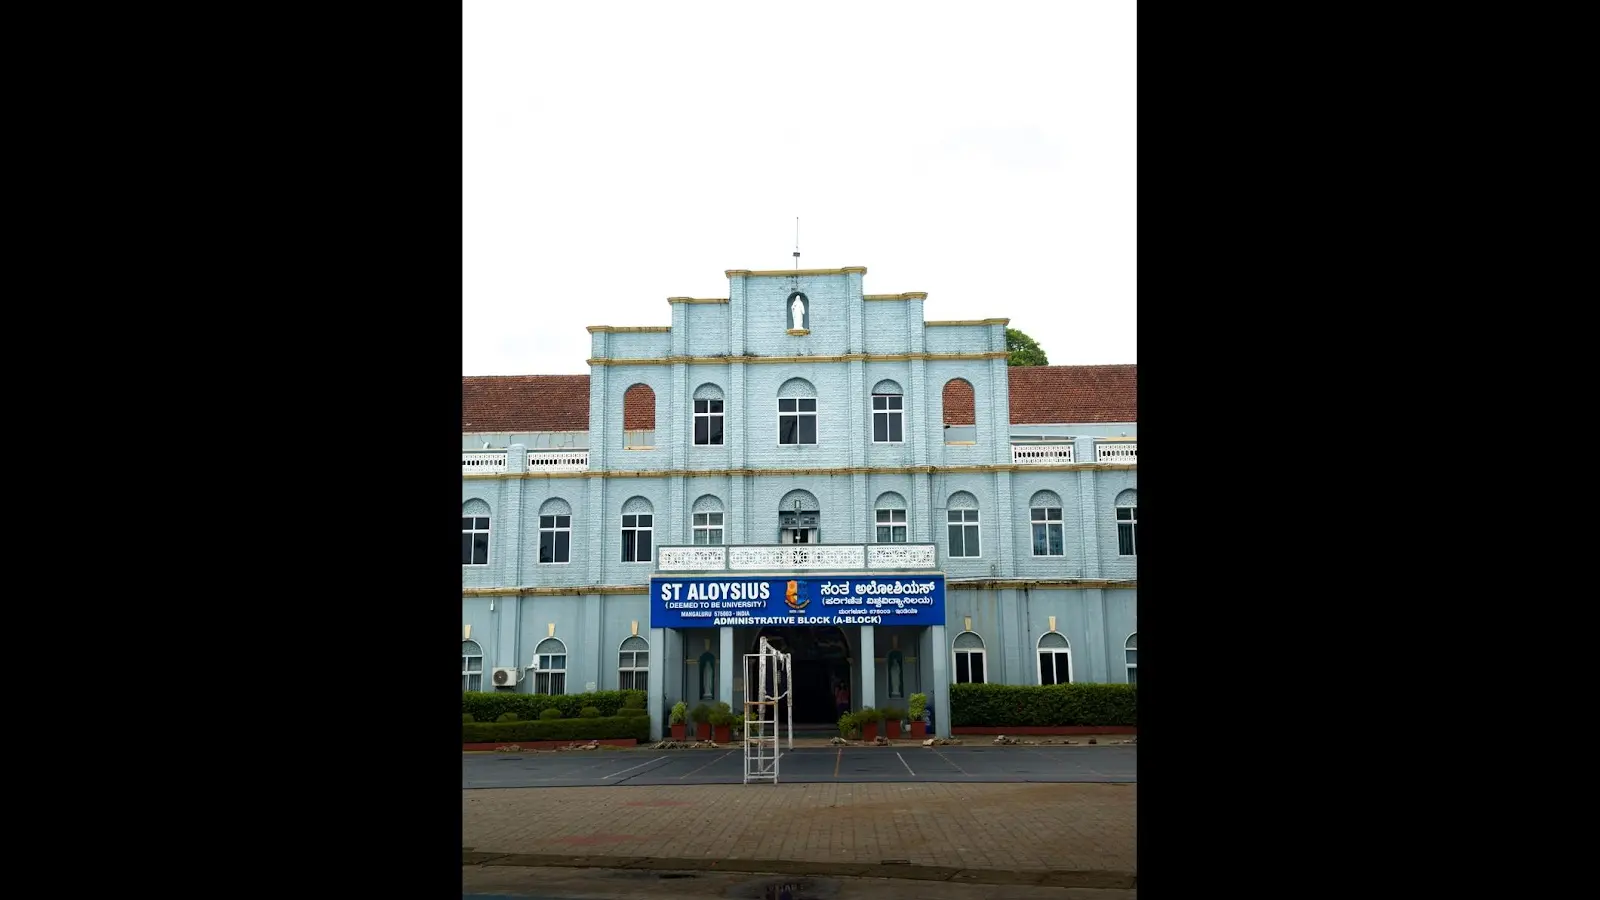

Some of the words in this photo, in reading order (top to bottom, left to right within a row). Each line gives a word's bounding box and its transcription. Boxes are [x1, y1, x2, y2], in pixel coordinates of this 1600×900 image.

[661, 583, 683, 601] ST
[687, 582, 770, 600] ALOYSIUS
[820, 581, 850, 595] ಸಂತ
[855, 580, 936, 595] ಅಲೋಶಿಯಸ್
[713, 616, 795, 625] ADMINISTRATIVE
[797, 616, 830, 624] BLOCK
[832, 616, 882, 625] (A-BLOCK)
